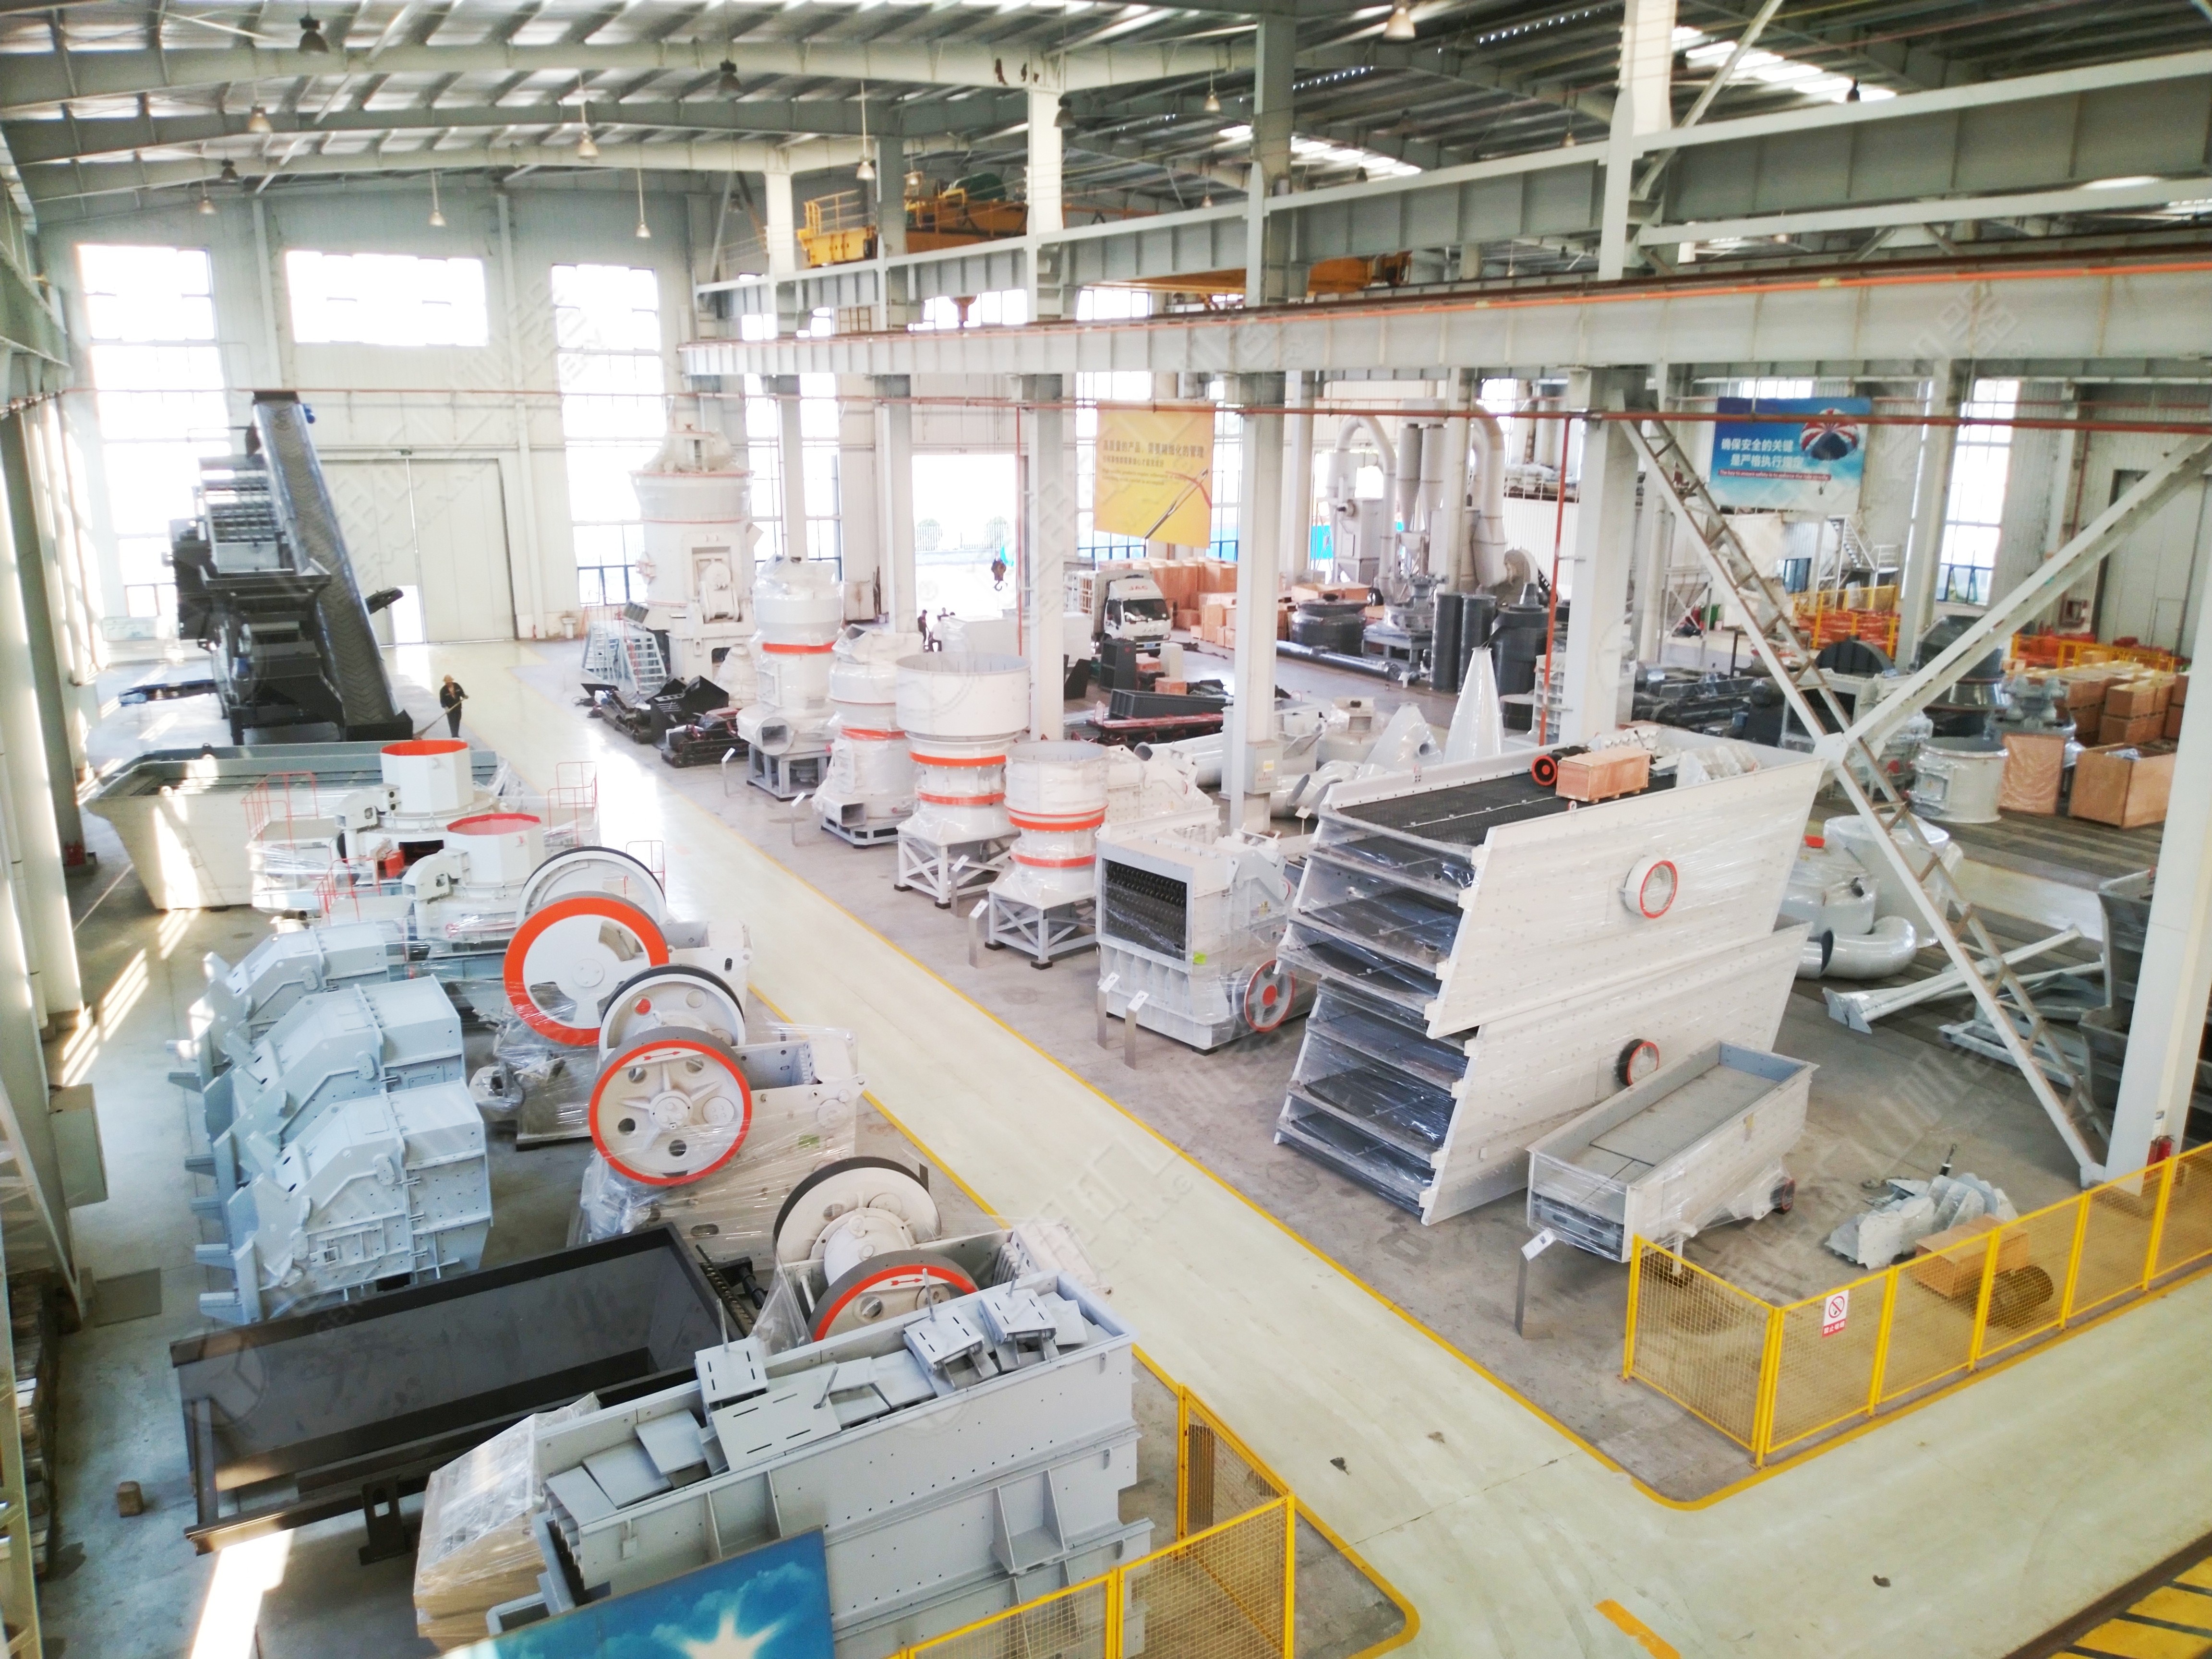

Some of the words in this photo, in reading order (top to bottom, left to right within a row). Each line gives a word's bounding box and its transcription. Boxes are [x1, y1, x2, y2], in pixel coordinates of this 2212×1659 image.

[1721, 438, 1794, 453] 确保安全的关键
[1824, 1321, 1845, 1334] 禁止吸烟
